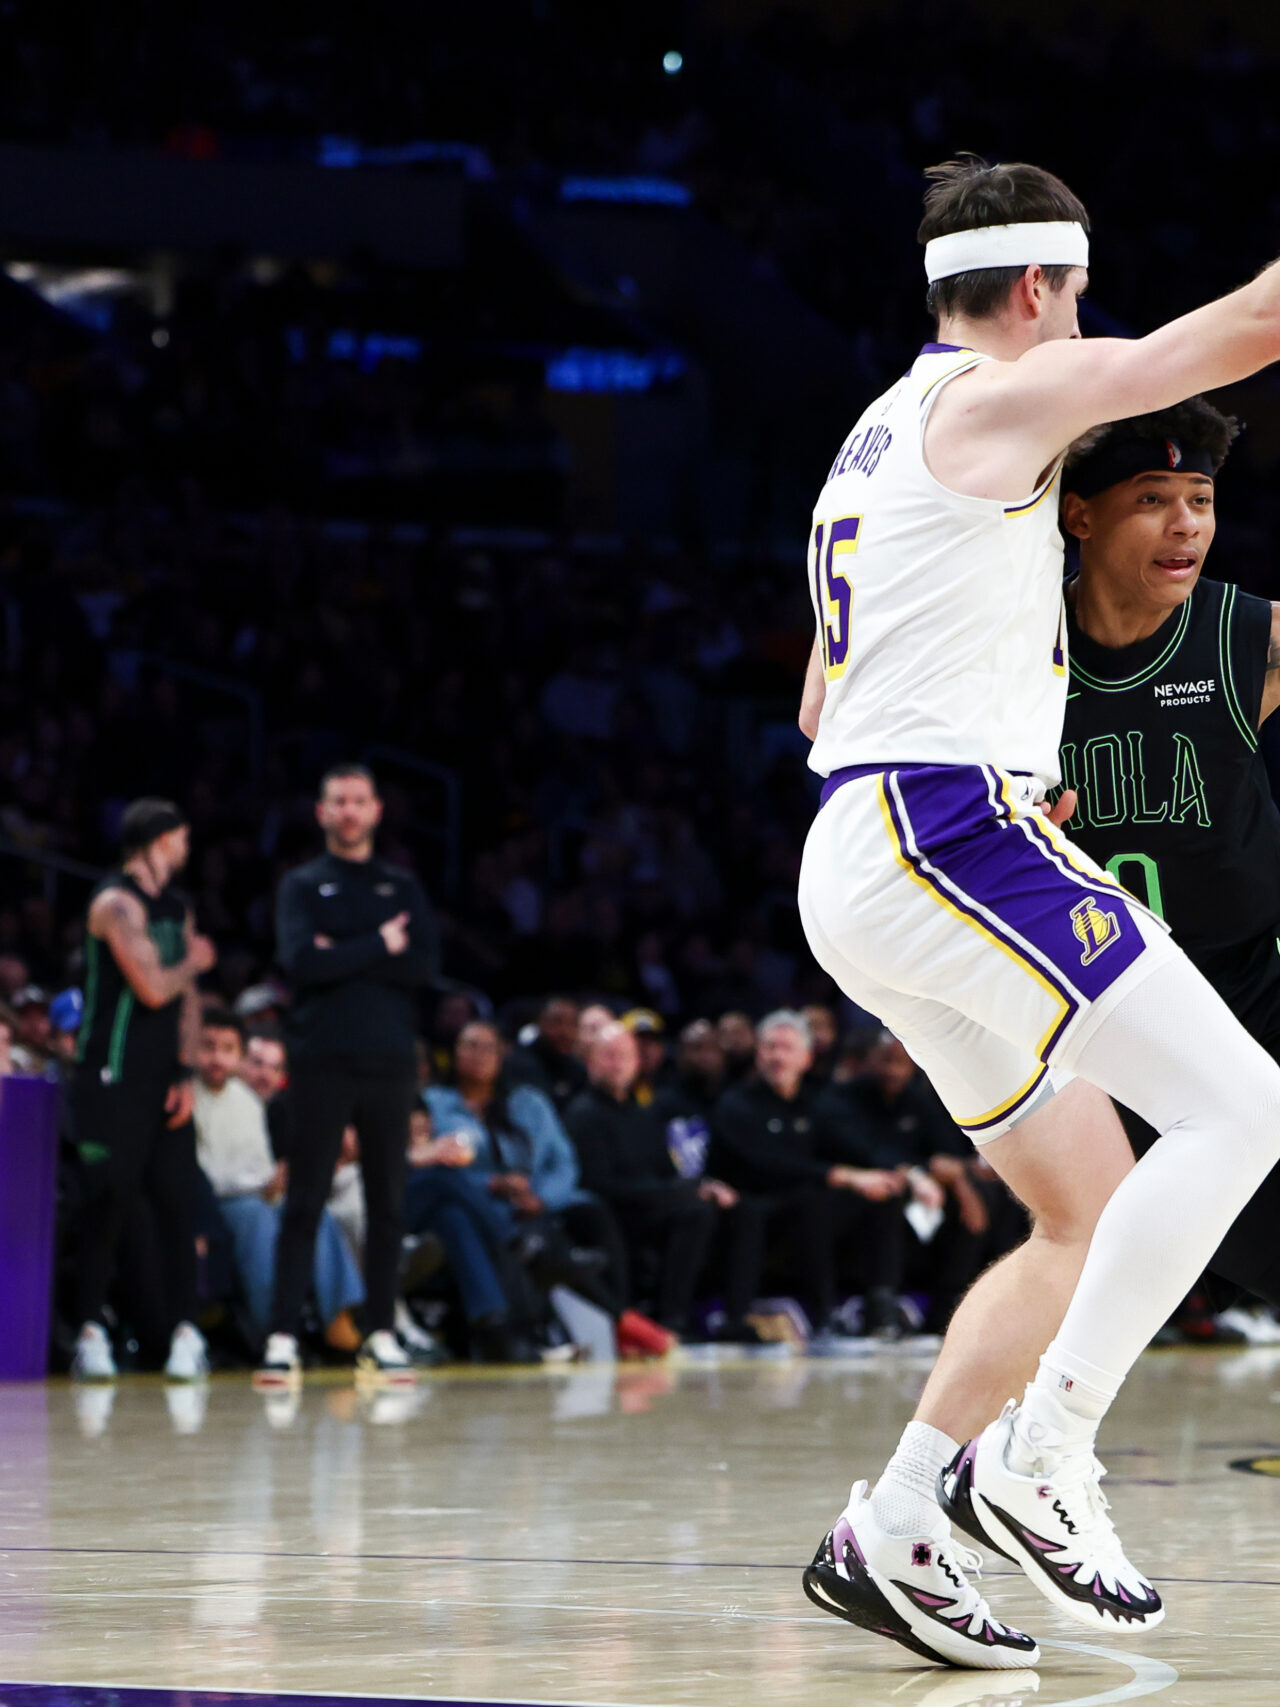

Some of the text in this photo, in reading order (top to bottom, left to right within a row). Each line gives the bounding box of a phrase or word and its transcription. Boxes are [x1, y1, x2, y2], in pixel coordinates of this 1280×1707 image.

[815, 513, 863, 683] 15
[1154, 679, 1216, 698] NEWAGE
[1160, 694, 1212, 708] PRODUCTS
